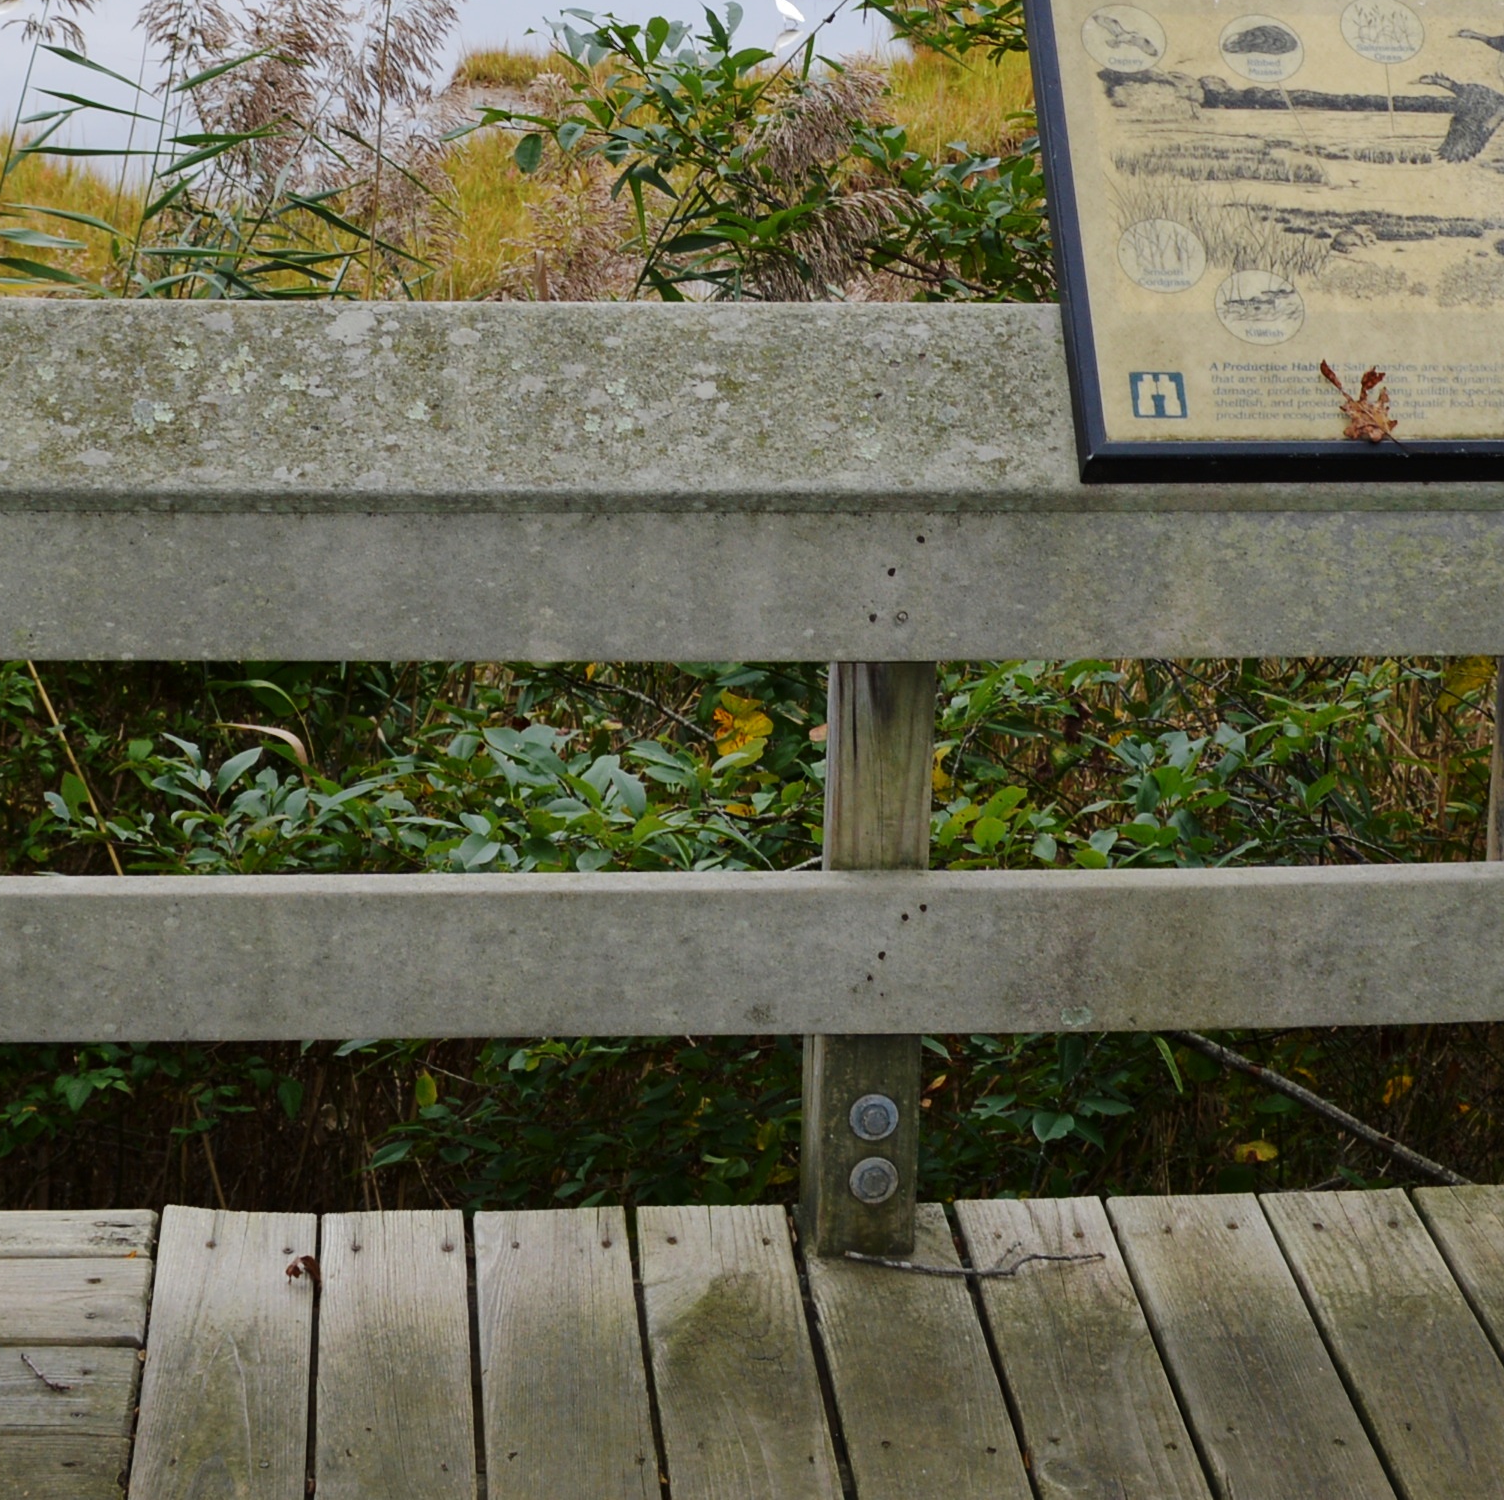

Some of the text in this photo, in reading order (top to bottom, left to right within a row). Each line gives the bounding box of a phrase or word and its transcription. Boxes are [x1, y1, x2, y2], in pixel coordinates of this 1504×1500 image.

[1108, 57, 1144, 68] Osprey
[1247, 58, 1281, 67] Ribbed
[1209, 363, 1218, 371] A
[1223, 363, 1288, 372] Productive
[1211, 375, 1234, 383] that
[1260, 374, 1321, 383] influenced
[1416, 374, 1447, 383] These
[1270, 399, 1293, 408] and
[1216, 411, 1282, 421] productive
